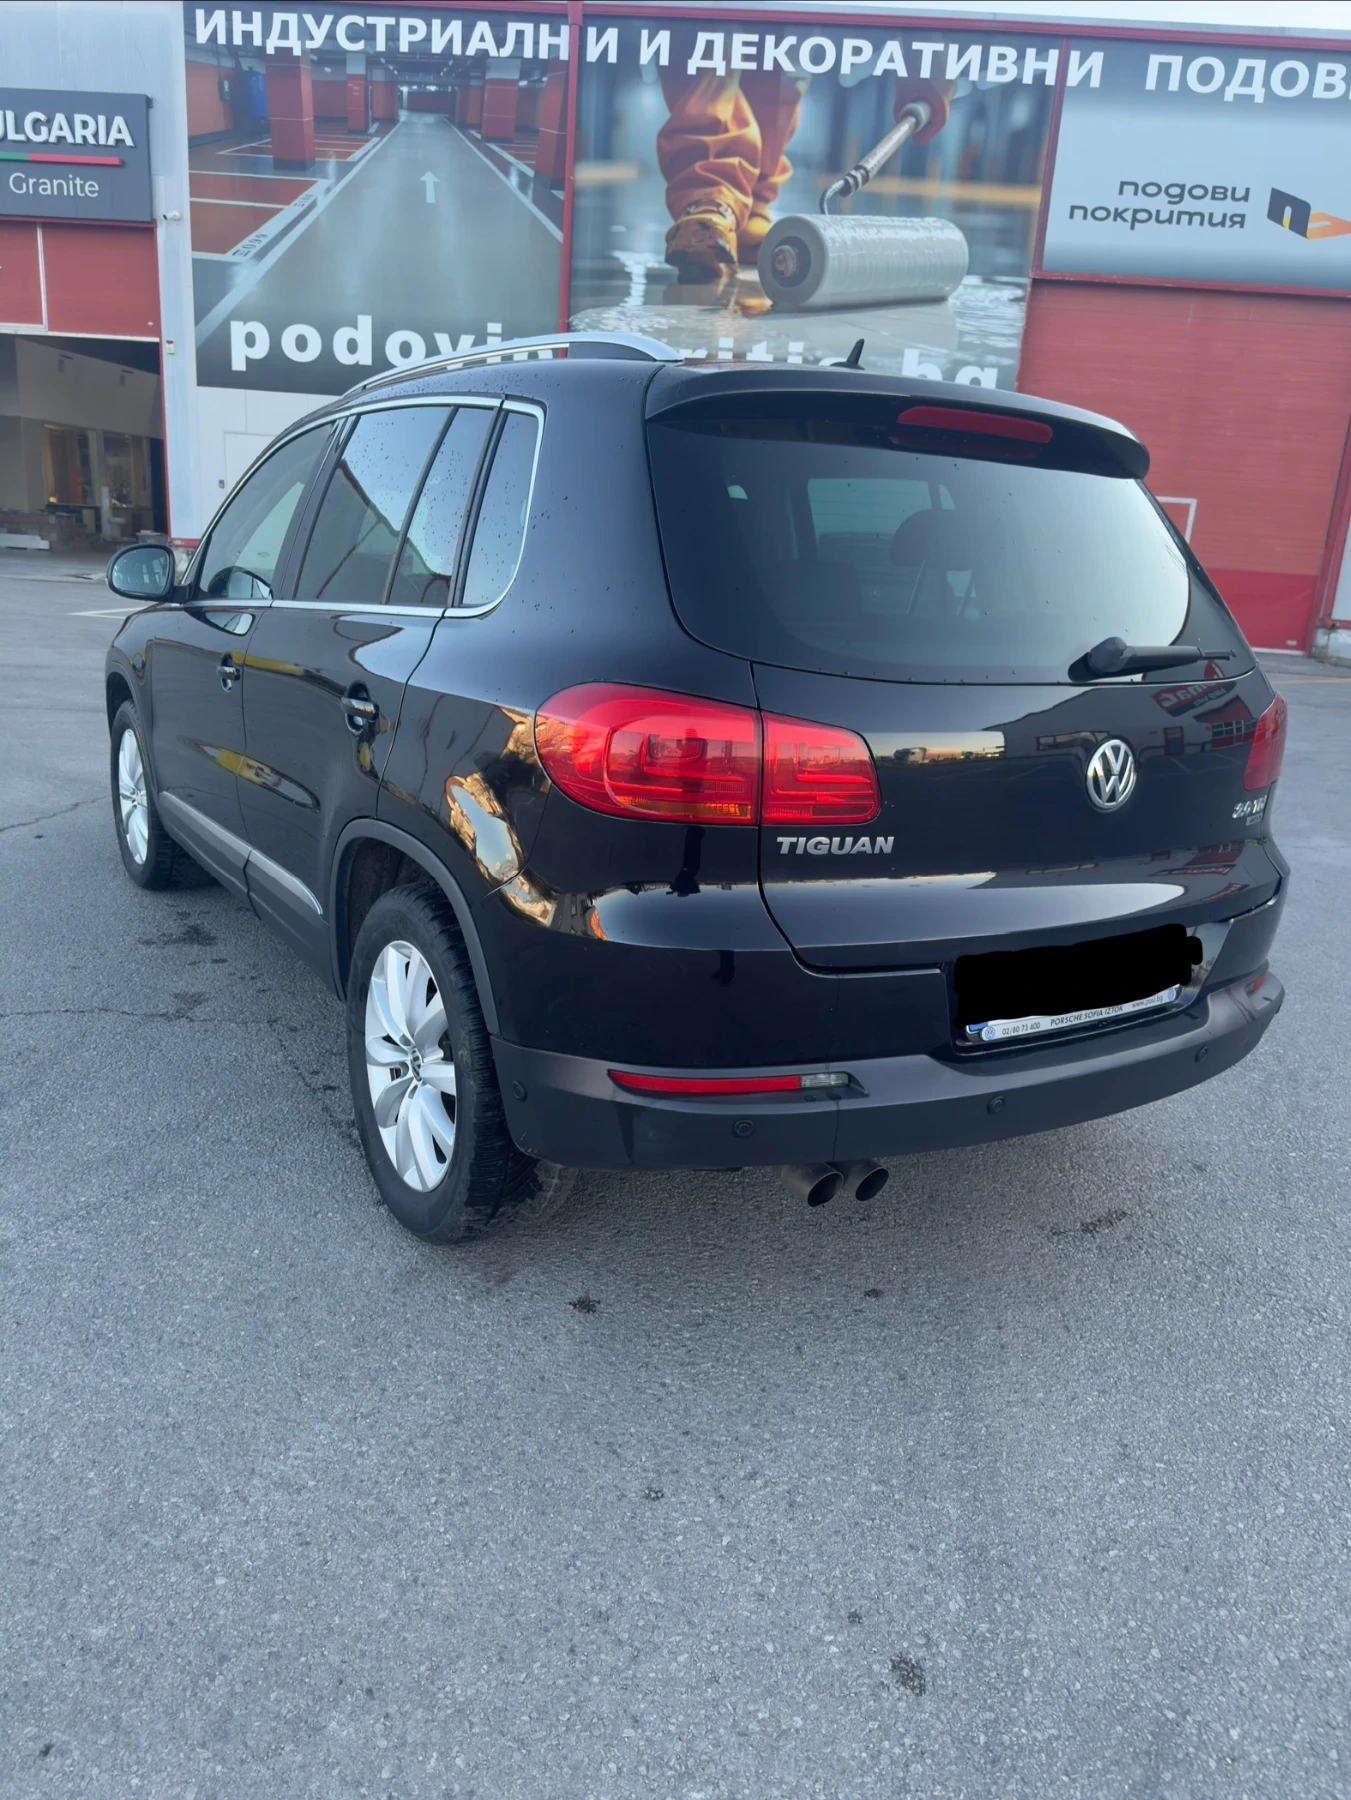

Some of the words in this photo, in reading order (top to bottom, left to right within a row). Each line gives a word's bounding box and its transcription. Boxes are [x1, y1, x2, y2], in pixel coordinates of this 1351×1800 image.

[640, 29, 671, 66] И
[1145, 54, 1351, 103] ПОДОВ
[0, 110, 135, 147] LGARIA
[9, 172, 100, 198] Granite
[1118, 180, 1251, 205] подови
[1069, 204, 1247, 231] покрития
[776, 836, 895, 856] TIGUAN
[1050, 1013, 1083, 1027] PORSCHE
[1084, 1009, 1103, 1020] SOFIA
